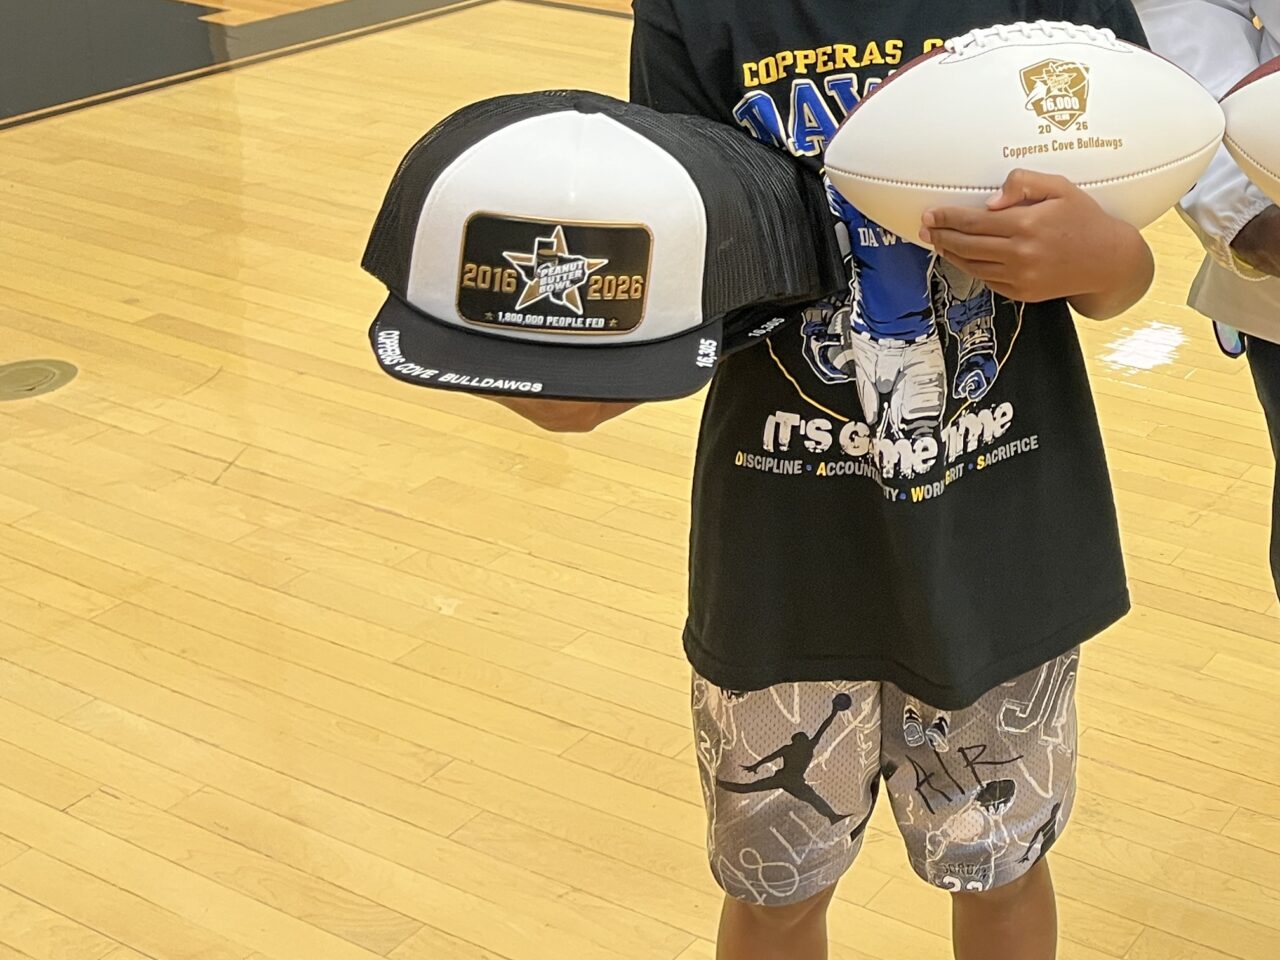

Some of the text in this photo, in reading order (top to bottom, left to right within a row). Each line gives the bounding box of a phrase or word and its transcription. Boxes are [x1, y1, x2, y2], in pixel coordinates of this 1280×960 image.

[742, 39, 903, 87] COPPERAS
[1040, 96, 1079, 112] 16,000
[1038, 121, 1088, 134] 20 26
[1003, 137, 1123, 158] Copperas Cove Bulldawgs
[540, 260, 584, 278] PEANUT
[540, 269, 583, 286] BUTTER
[462, 263, 644, 300] 2016 2026
[539, 280, 572, 294] BOWL
[498, 311, 605, 328] 1,800,000 PEOPLE FED
[695, 338, 717, 367] 16,305
[394, 363, 439, 379] COVE
[438, 373, 543, 392] BULLDAWGS
[763, 411, 833, 453] IT'S
[839, 421, 938, 479] Gme
[735, 450, 803, 475] DISCIPLINE
[945, 463, 965, 486] GRIT
[976, 435, 1039, 470] SACRIFICE
